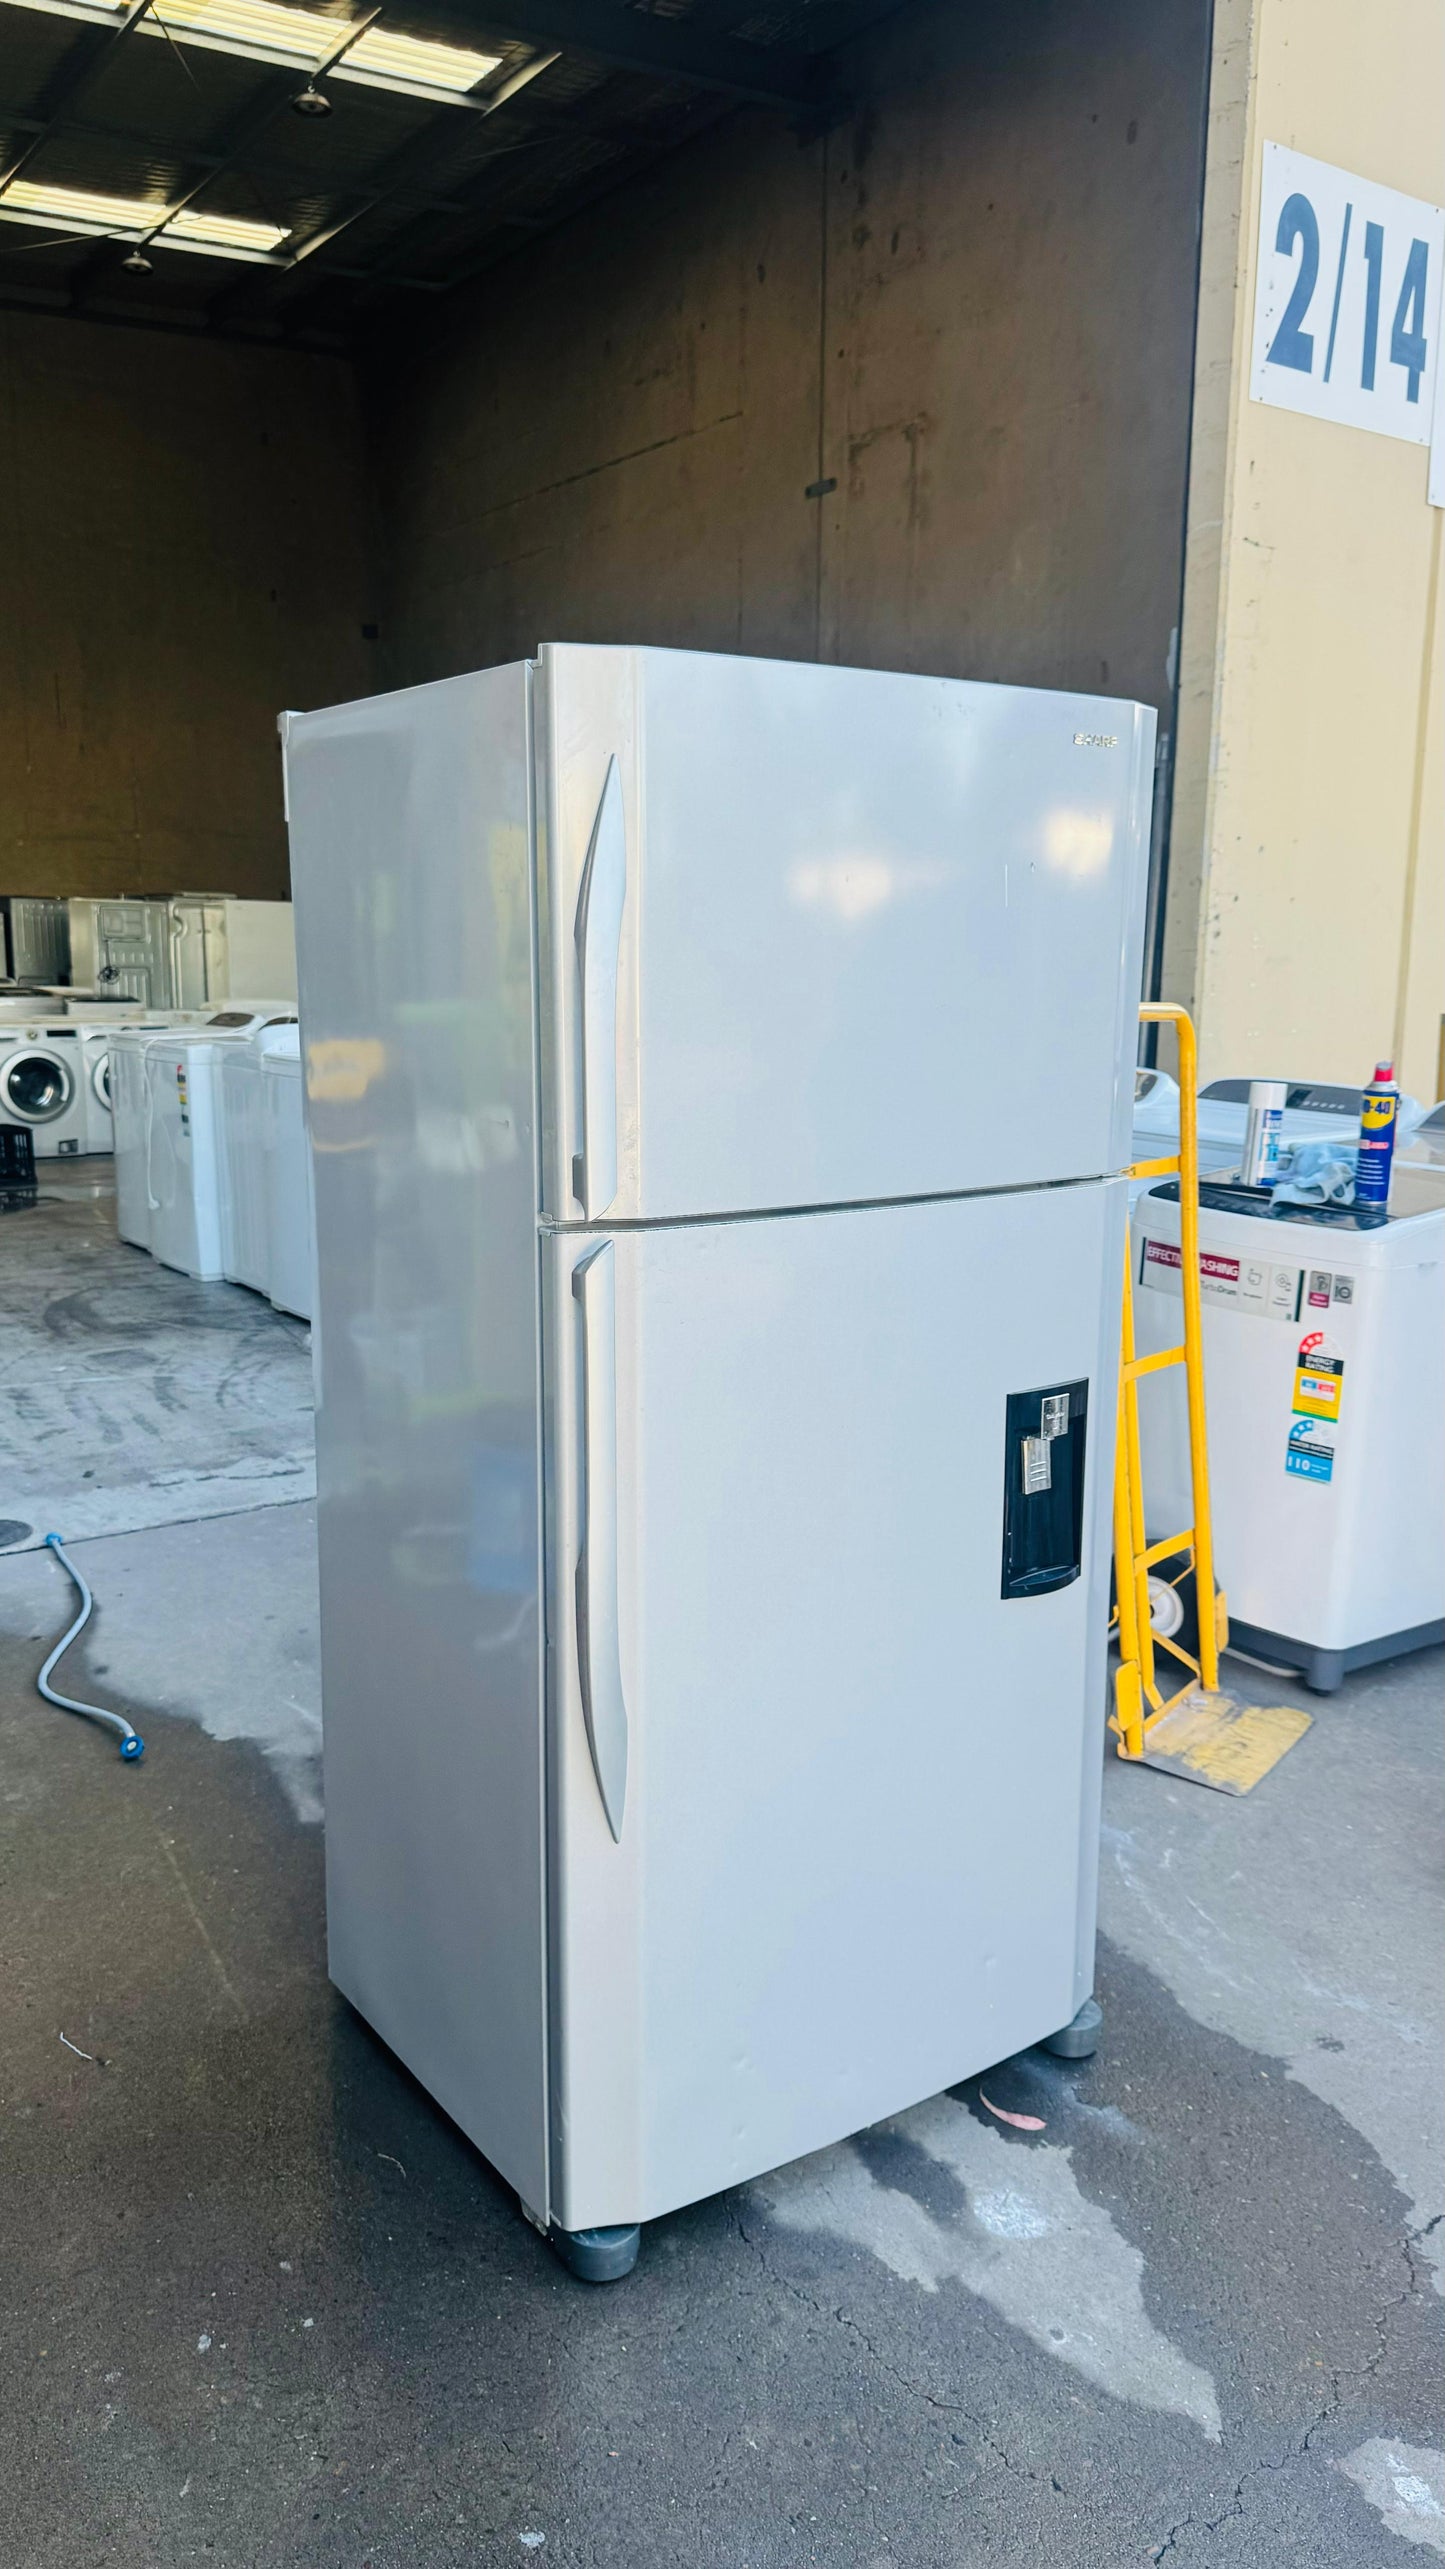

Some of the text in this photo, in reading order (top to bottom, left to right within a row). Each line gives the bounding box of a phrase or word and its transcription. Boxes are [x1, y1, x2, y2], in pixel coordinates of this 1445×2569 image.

[1266, 193, 1429, 404] 2/14
[1073, 733, 1118, 748] SHARP
[1148, 1246, 1239, 1277] EFFECTI ASHING
